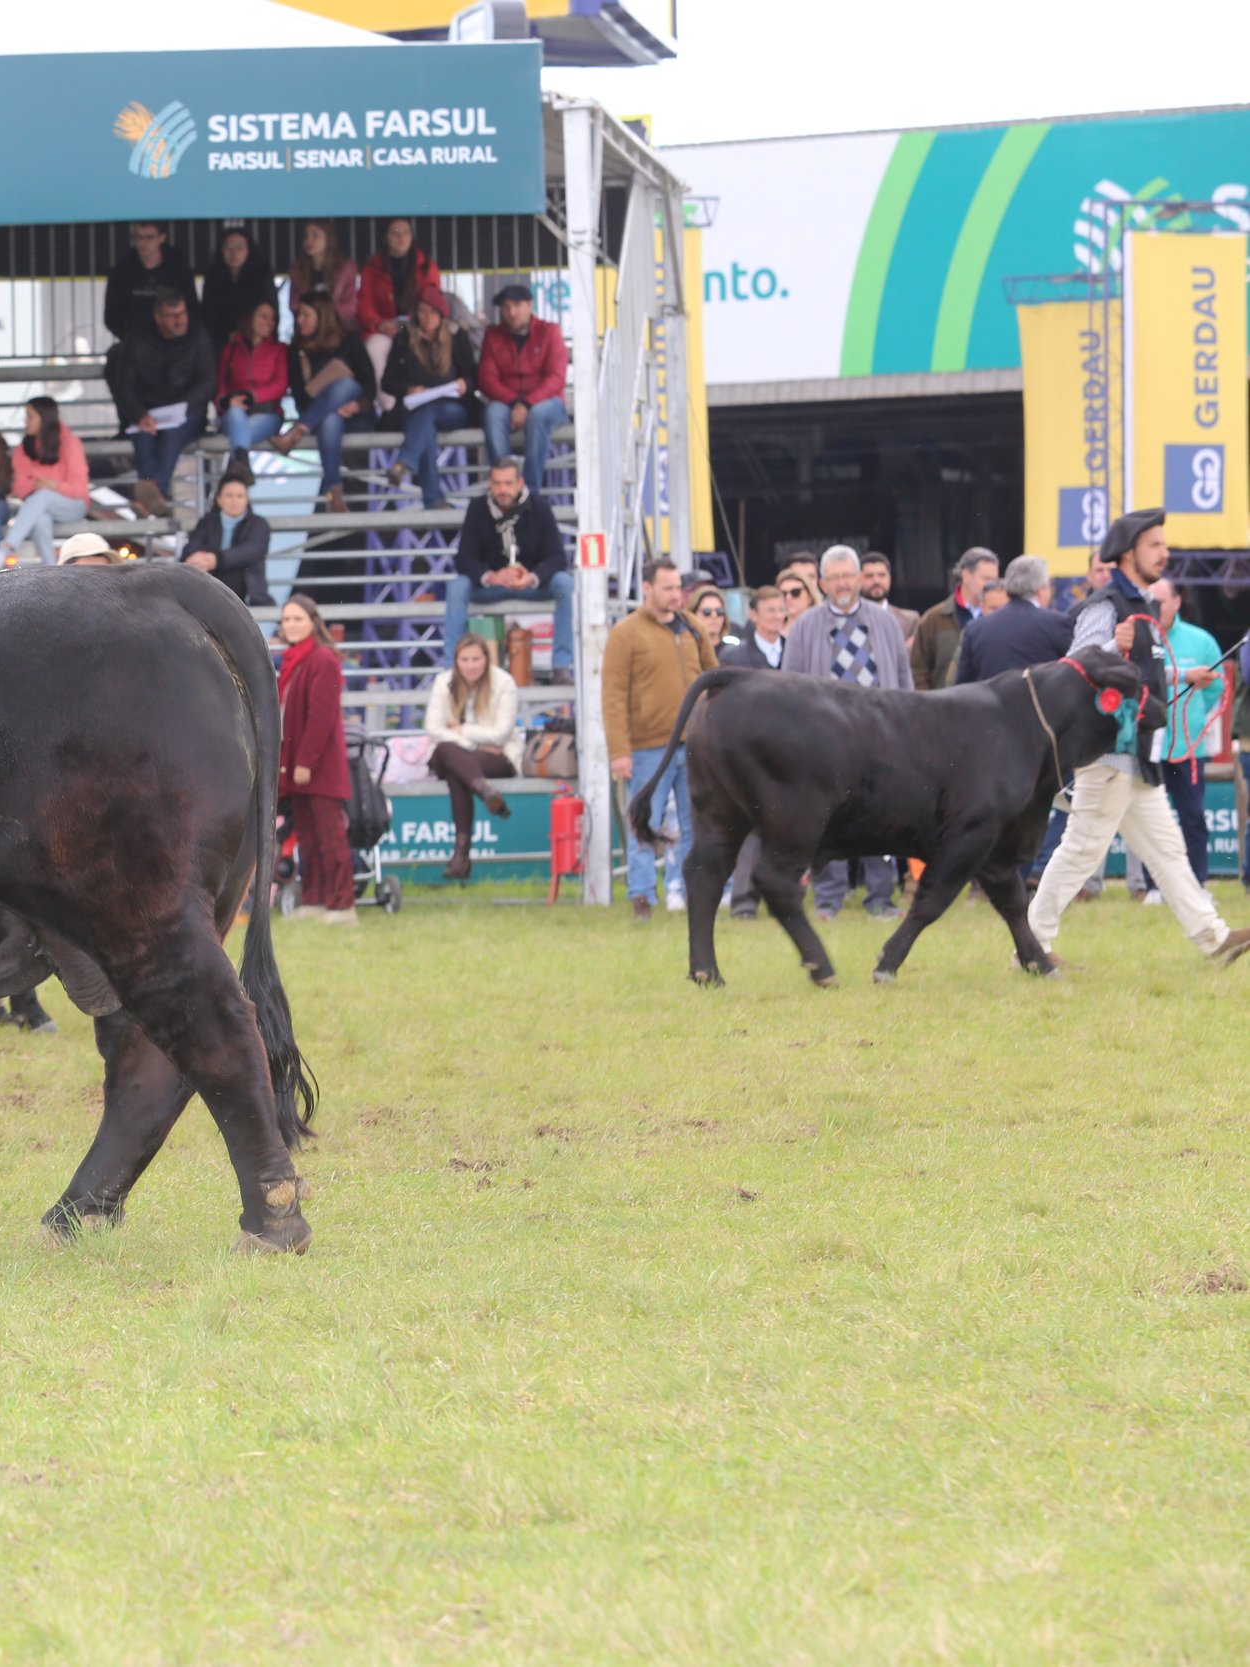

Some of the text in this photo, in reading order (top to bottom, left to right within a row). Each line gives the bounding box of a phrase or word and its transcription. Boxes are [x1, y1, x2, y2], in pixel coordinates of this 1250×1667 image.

[208, 107, 497, 143] SISTEMA FARSUL
[208, 145, 498, 170] FARSUL SENAR CASA RURAL
[704, 259, 791, 305] nto.
[1192, 266, 1220, 430] GERDAU
